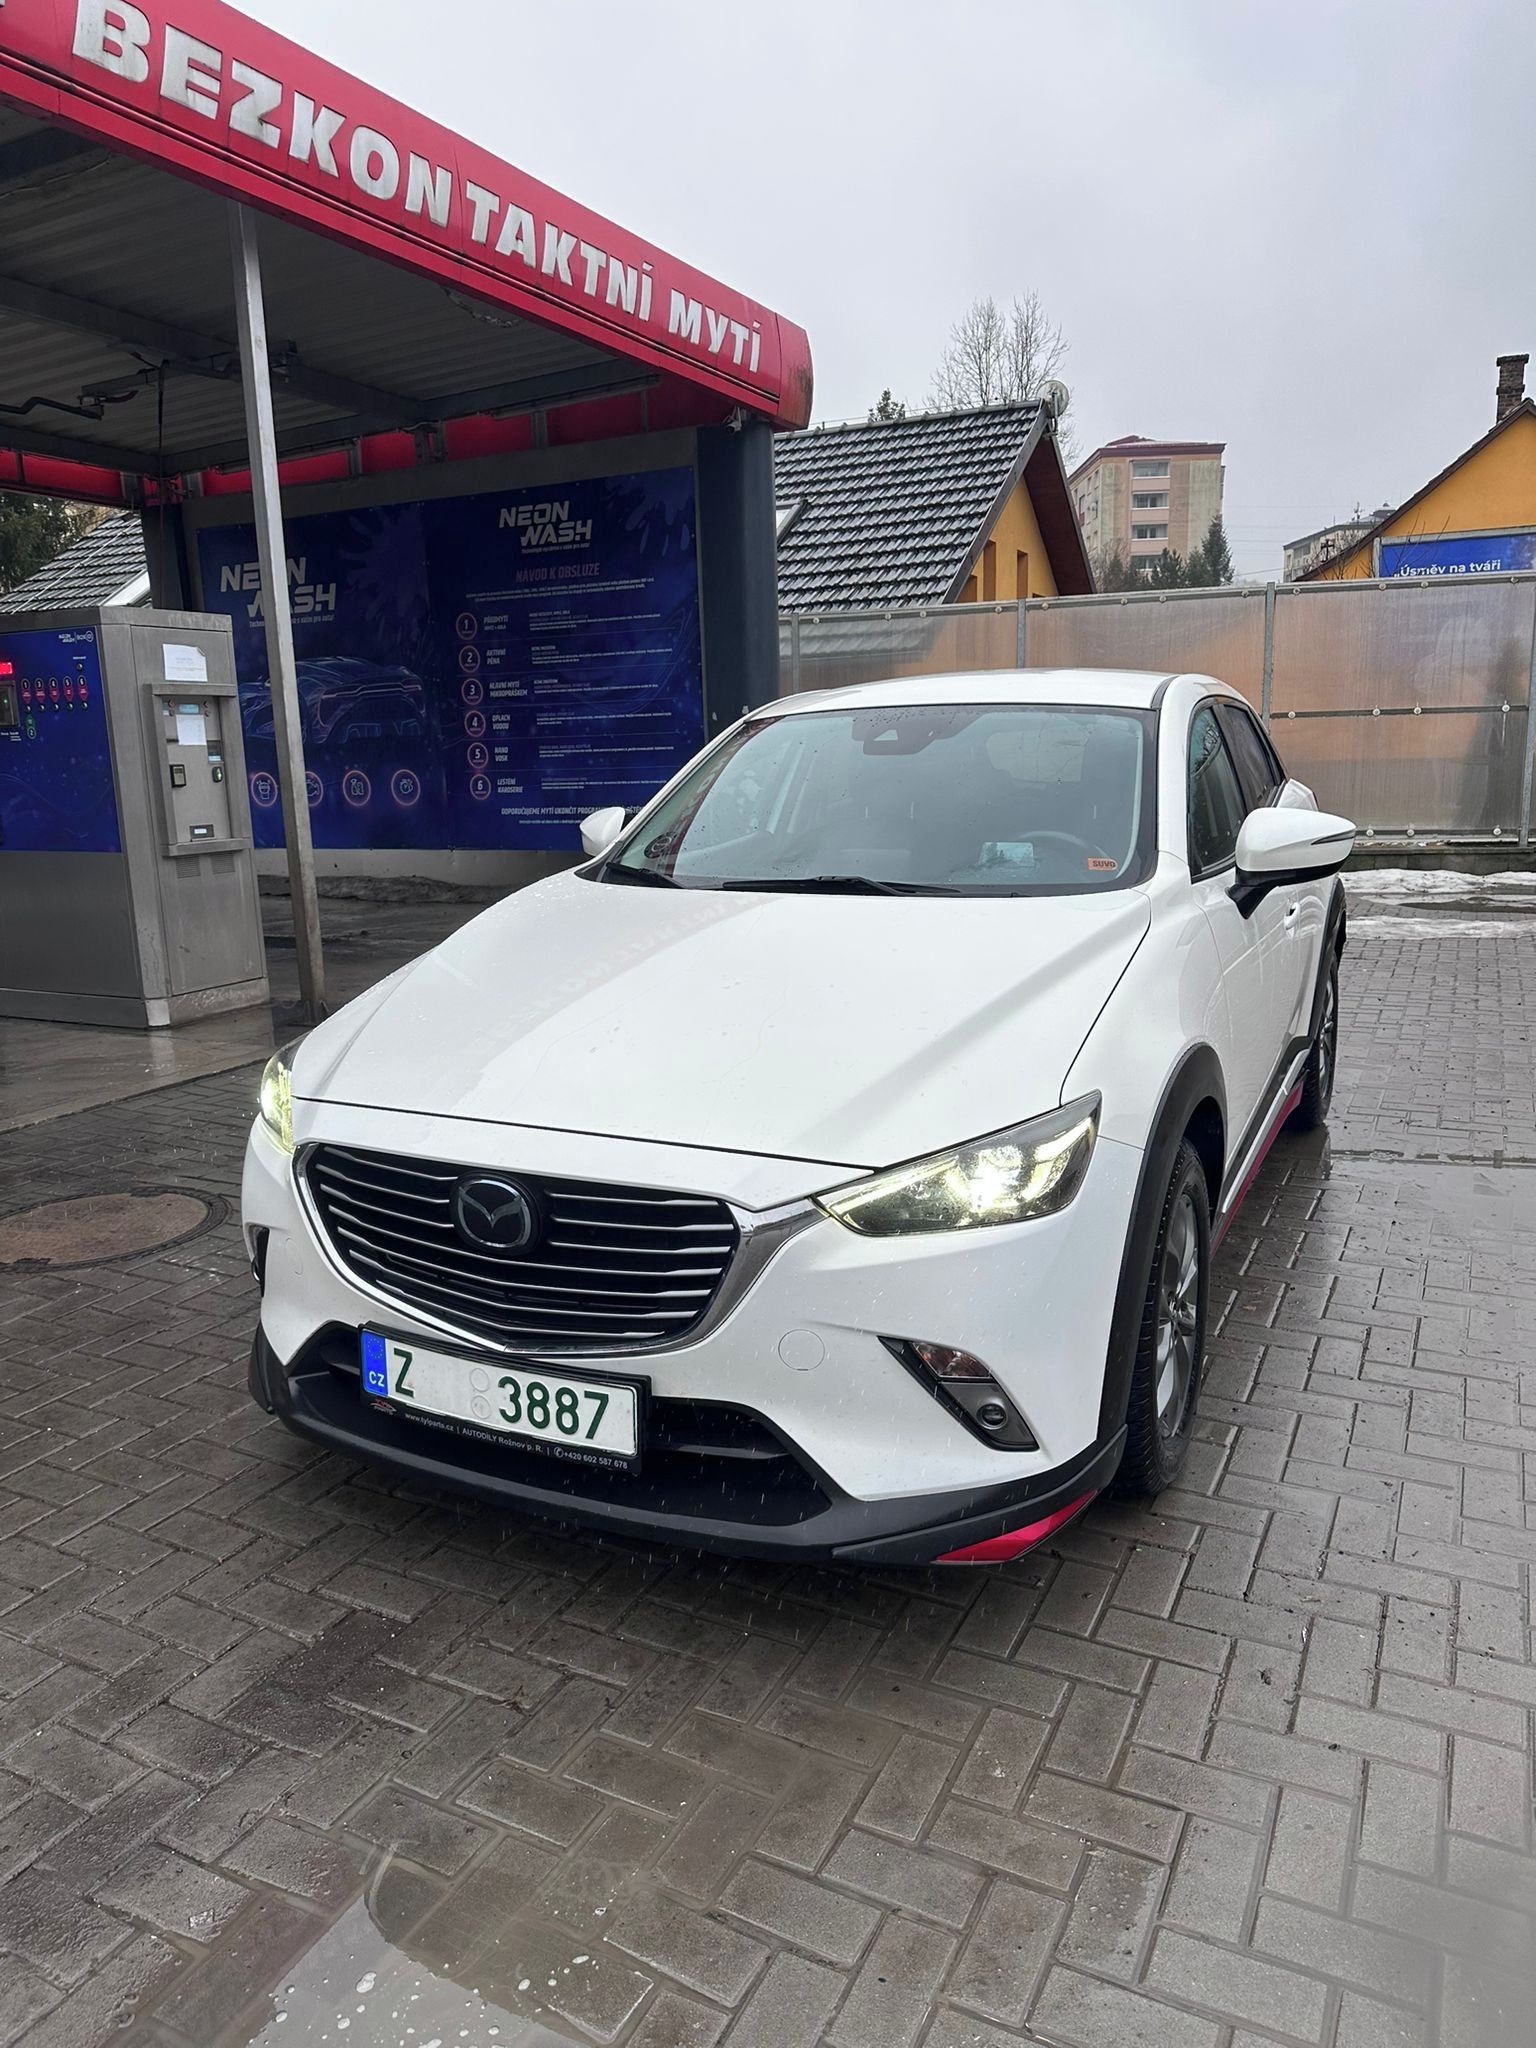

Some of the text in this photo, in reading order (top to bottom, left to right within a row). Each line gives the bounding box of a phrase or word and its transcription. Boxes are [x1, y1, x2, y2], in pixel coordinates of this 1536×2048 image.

[668, 288, 760, 373] MYTÍ
[499, 501, 570, 528] NEON
[520, 519, 593, 547] WASH
[220, 556, 307, 593] NEN
[549, 567, 556, 580] K
[1449, 565, 1466, 574] na
[1469, 560, 1501, 572] tváři
[247, 582, 337, 618] WSH
[464, 619, 469, 630] 1
[467, 652, 473, 663] 2
[469, 684, 475, 695] 3
[472, 717, 478, 727] 4
[475, 748, 481, 759] 5
[477, 780, 483, 790] 6
[369, 1370, 385, 1387] CZ
[393, 1347, 610, 1439] Z 3887
[462, 1427, 497, 1443] AUTODÍLY
[583, 1454, 597, 1464] 602
[614, 1459, 628, 1469] 678
